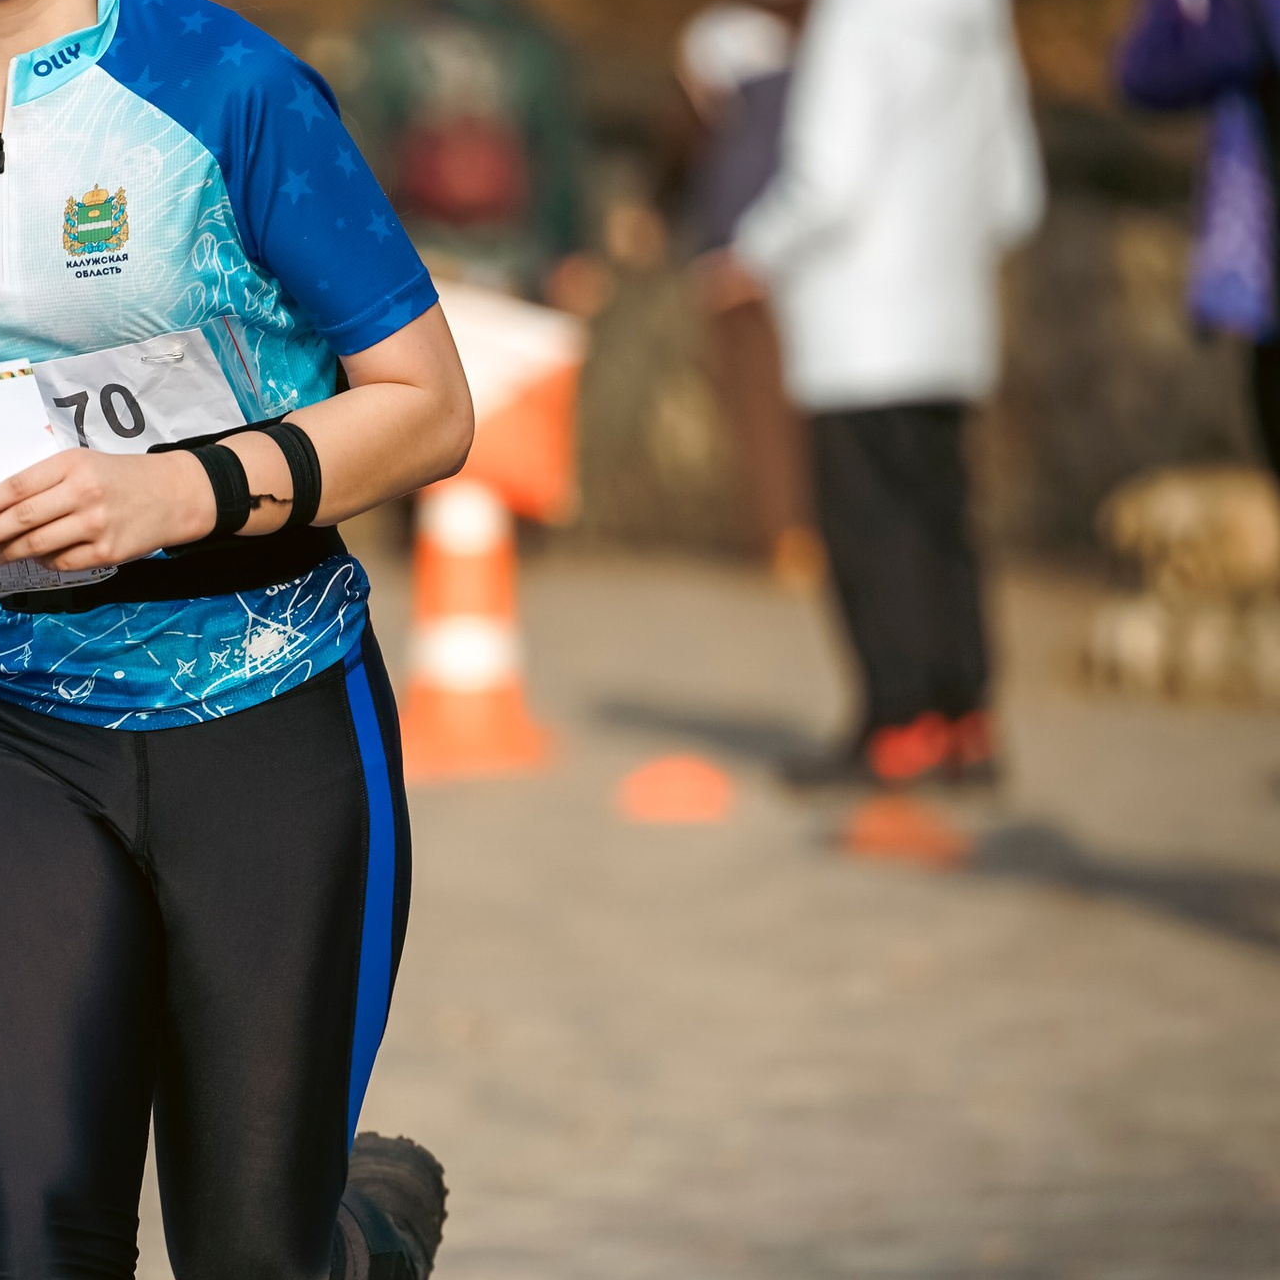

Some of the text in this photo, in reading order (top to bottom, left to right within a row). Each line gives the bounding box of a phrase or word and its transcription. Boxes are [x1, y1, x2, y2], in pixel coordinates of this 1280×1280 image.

[66, 253, 129, 269] КАЛУЖСКАЯ
[75, 266, 122, 279] ОБЛАСТЬ
[52, 383, 146, 449] 70
